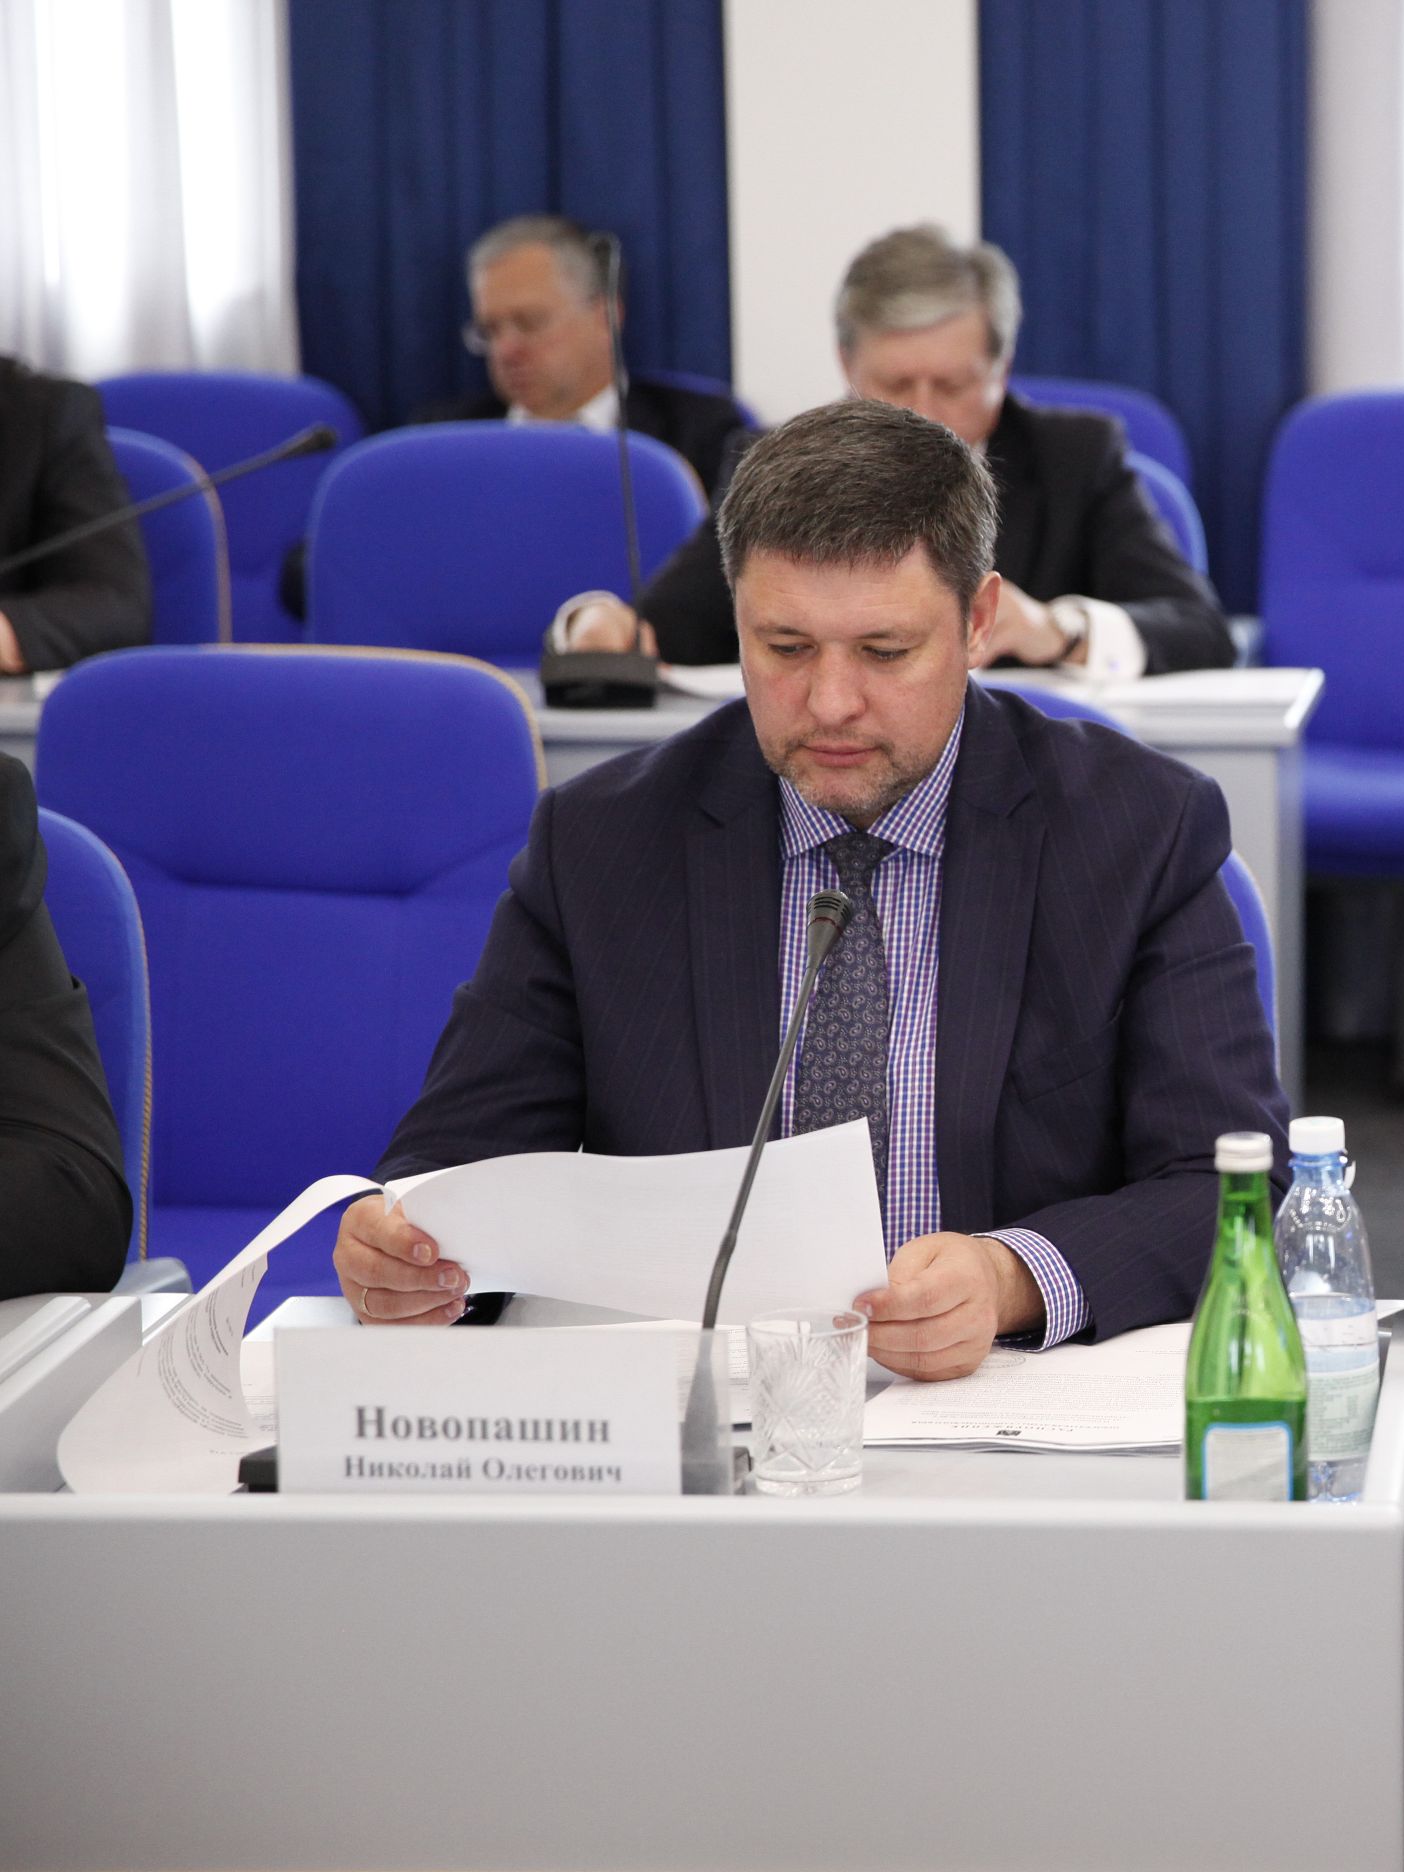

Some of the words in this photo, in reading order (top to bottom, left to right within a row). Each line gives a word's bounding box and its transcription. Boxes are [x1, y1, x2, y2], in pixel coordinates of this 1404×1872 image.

[354, 1404, 611, 1444] Новопашин
[343, 1456, 472, 1481] Николай
[482, 1456, 622, 1483] Олегович
